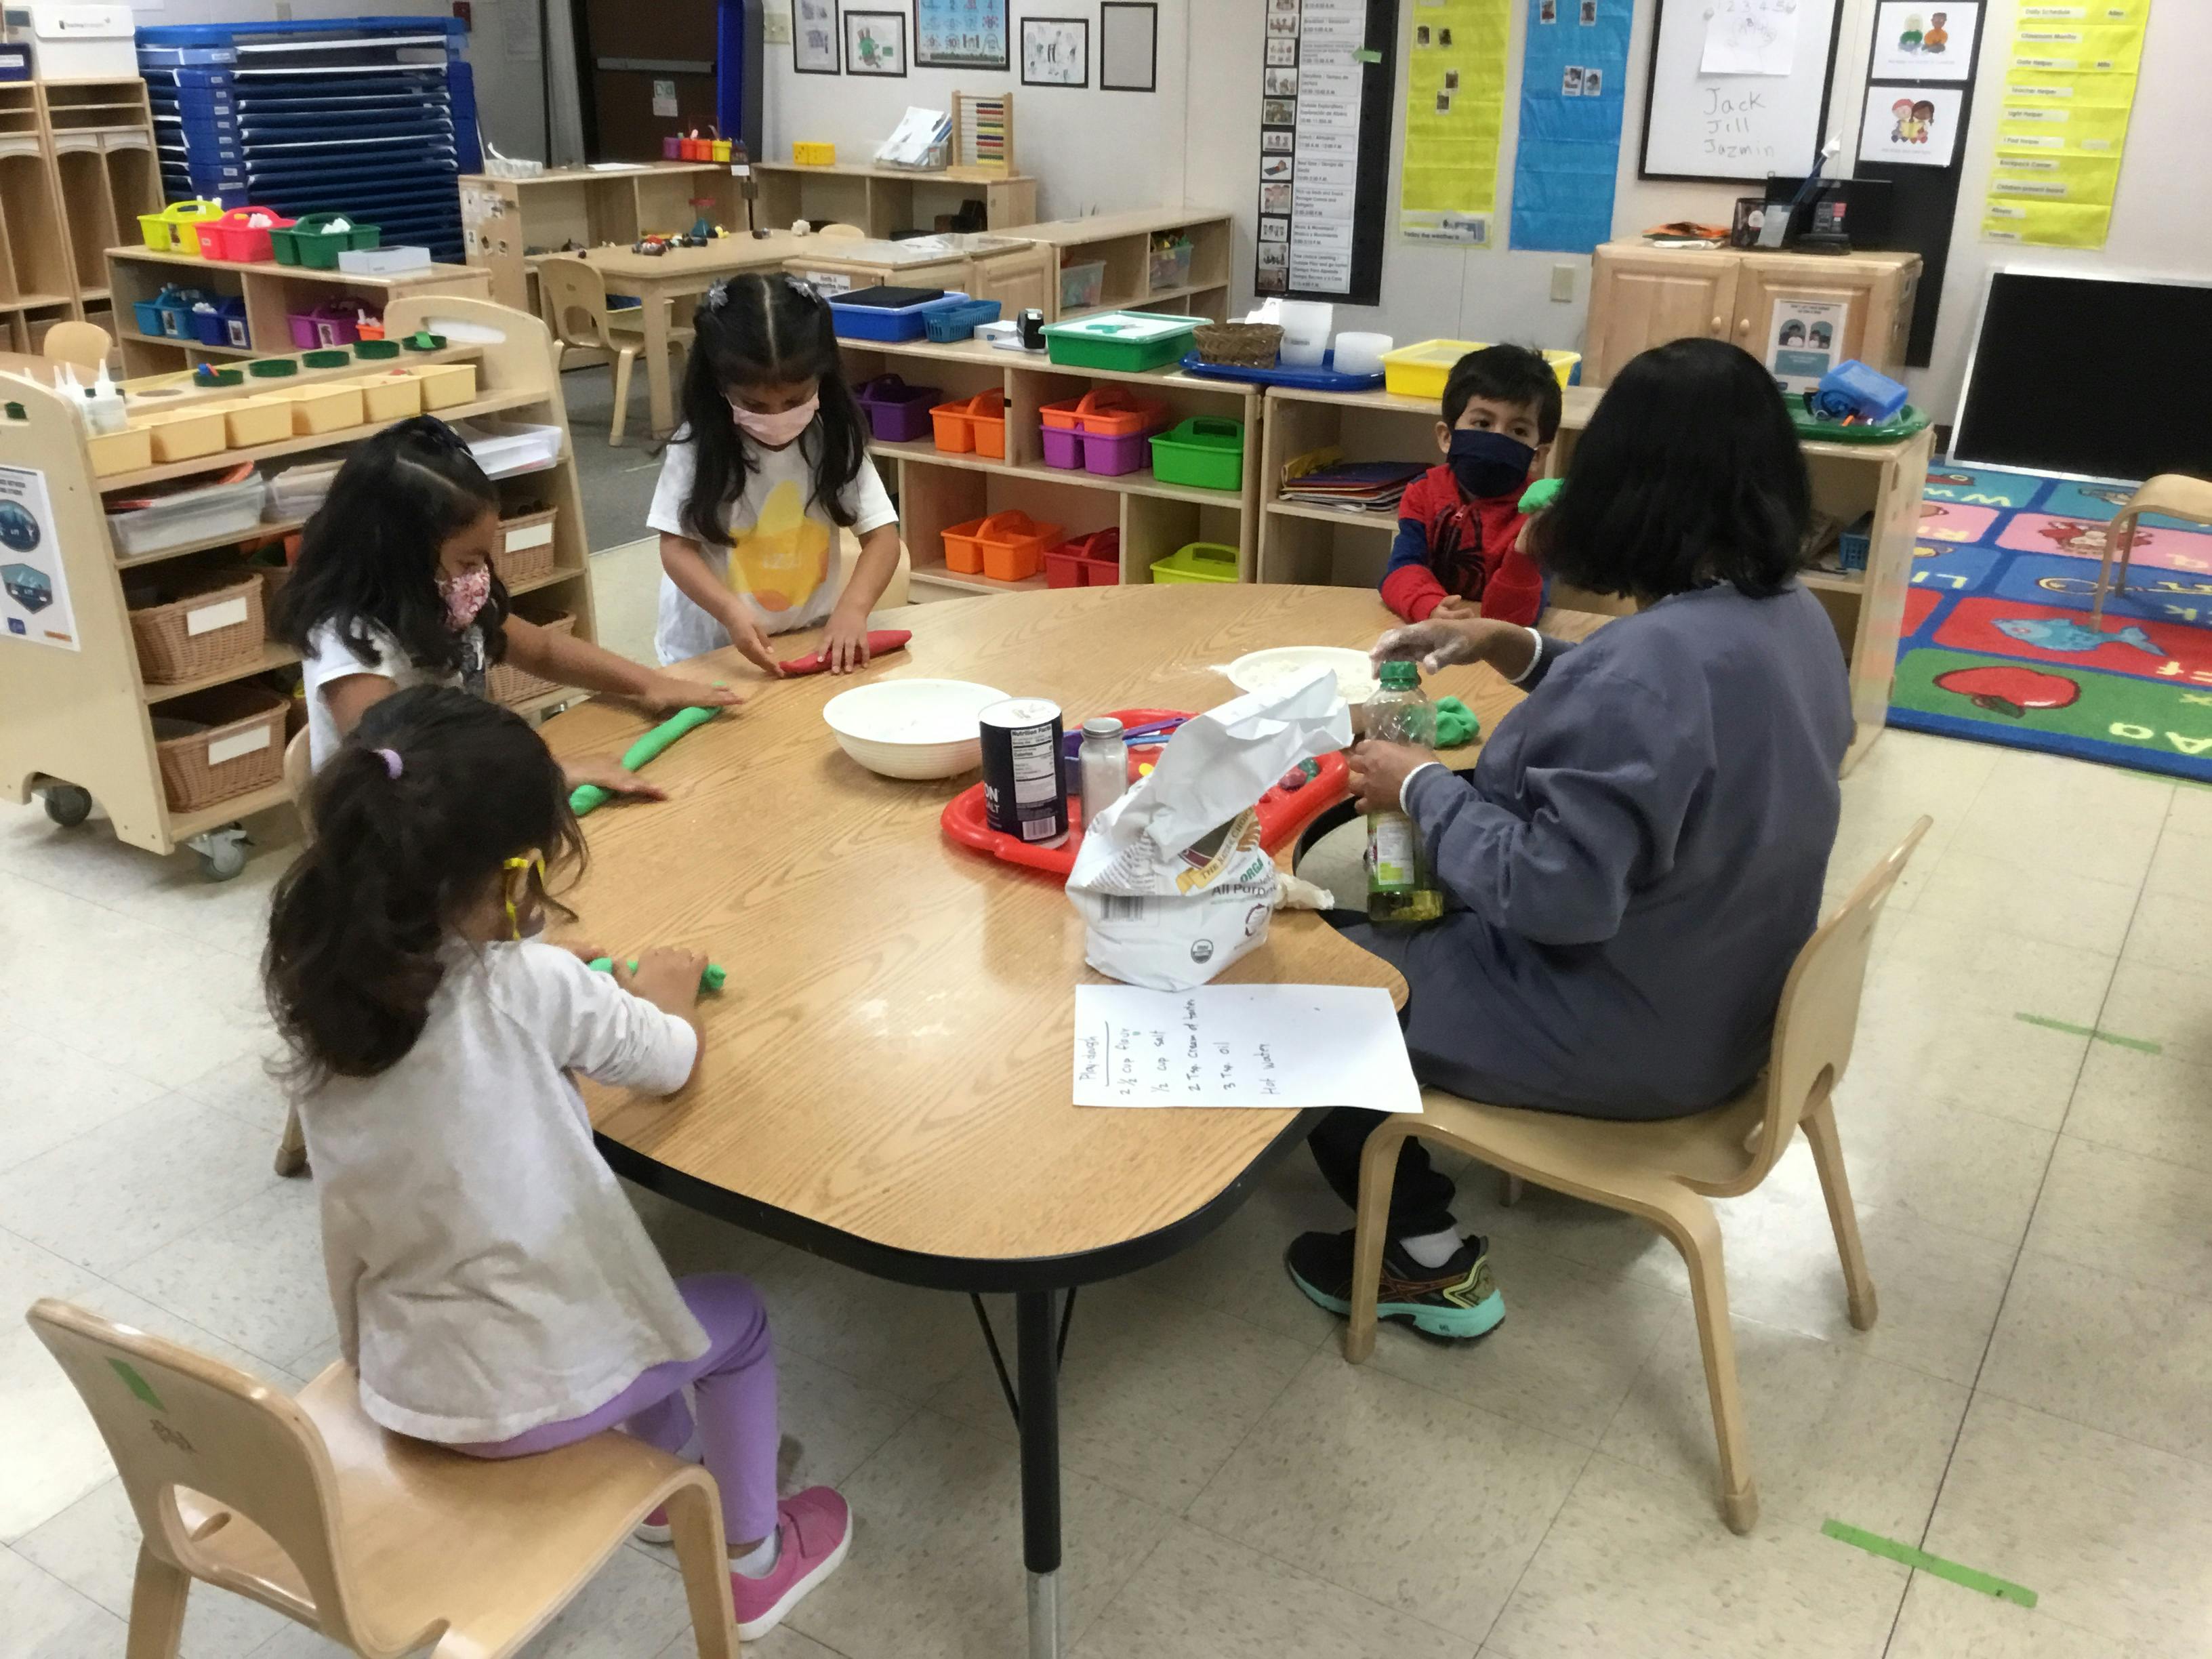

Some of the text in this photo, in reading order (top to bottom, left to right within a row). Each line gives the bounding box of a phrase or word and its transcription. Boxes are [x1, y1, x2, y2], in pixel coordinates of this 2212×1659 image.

[1703, 87, 1767, 116] Jack
[1706, 117, 1750, 134] Jill
[1703, 138, 1775, 158] Jazmin
[1201, 863, 1219, 880] THE
[1212, 884, 1230, 897] All
[1183, 1023, 1199, 1031] of
[1115, 1028, 1130, 1050] flour
[1149, 1030, 1166, 1047] salt
[1122, 1057, 1134, 1073] cup
[1157, 1057, 1170, 1071] cup
[1188, 1084, 1201, 1092] 2
[1223, 1082, 1236, 1090] 3
[1258, 1078, 1281, 1095] Hot
